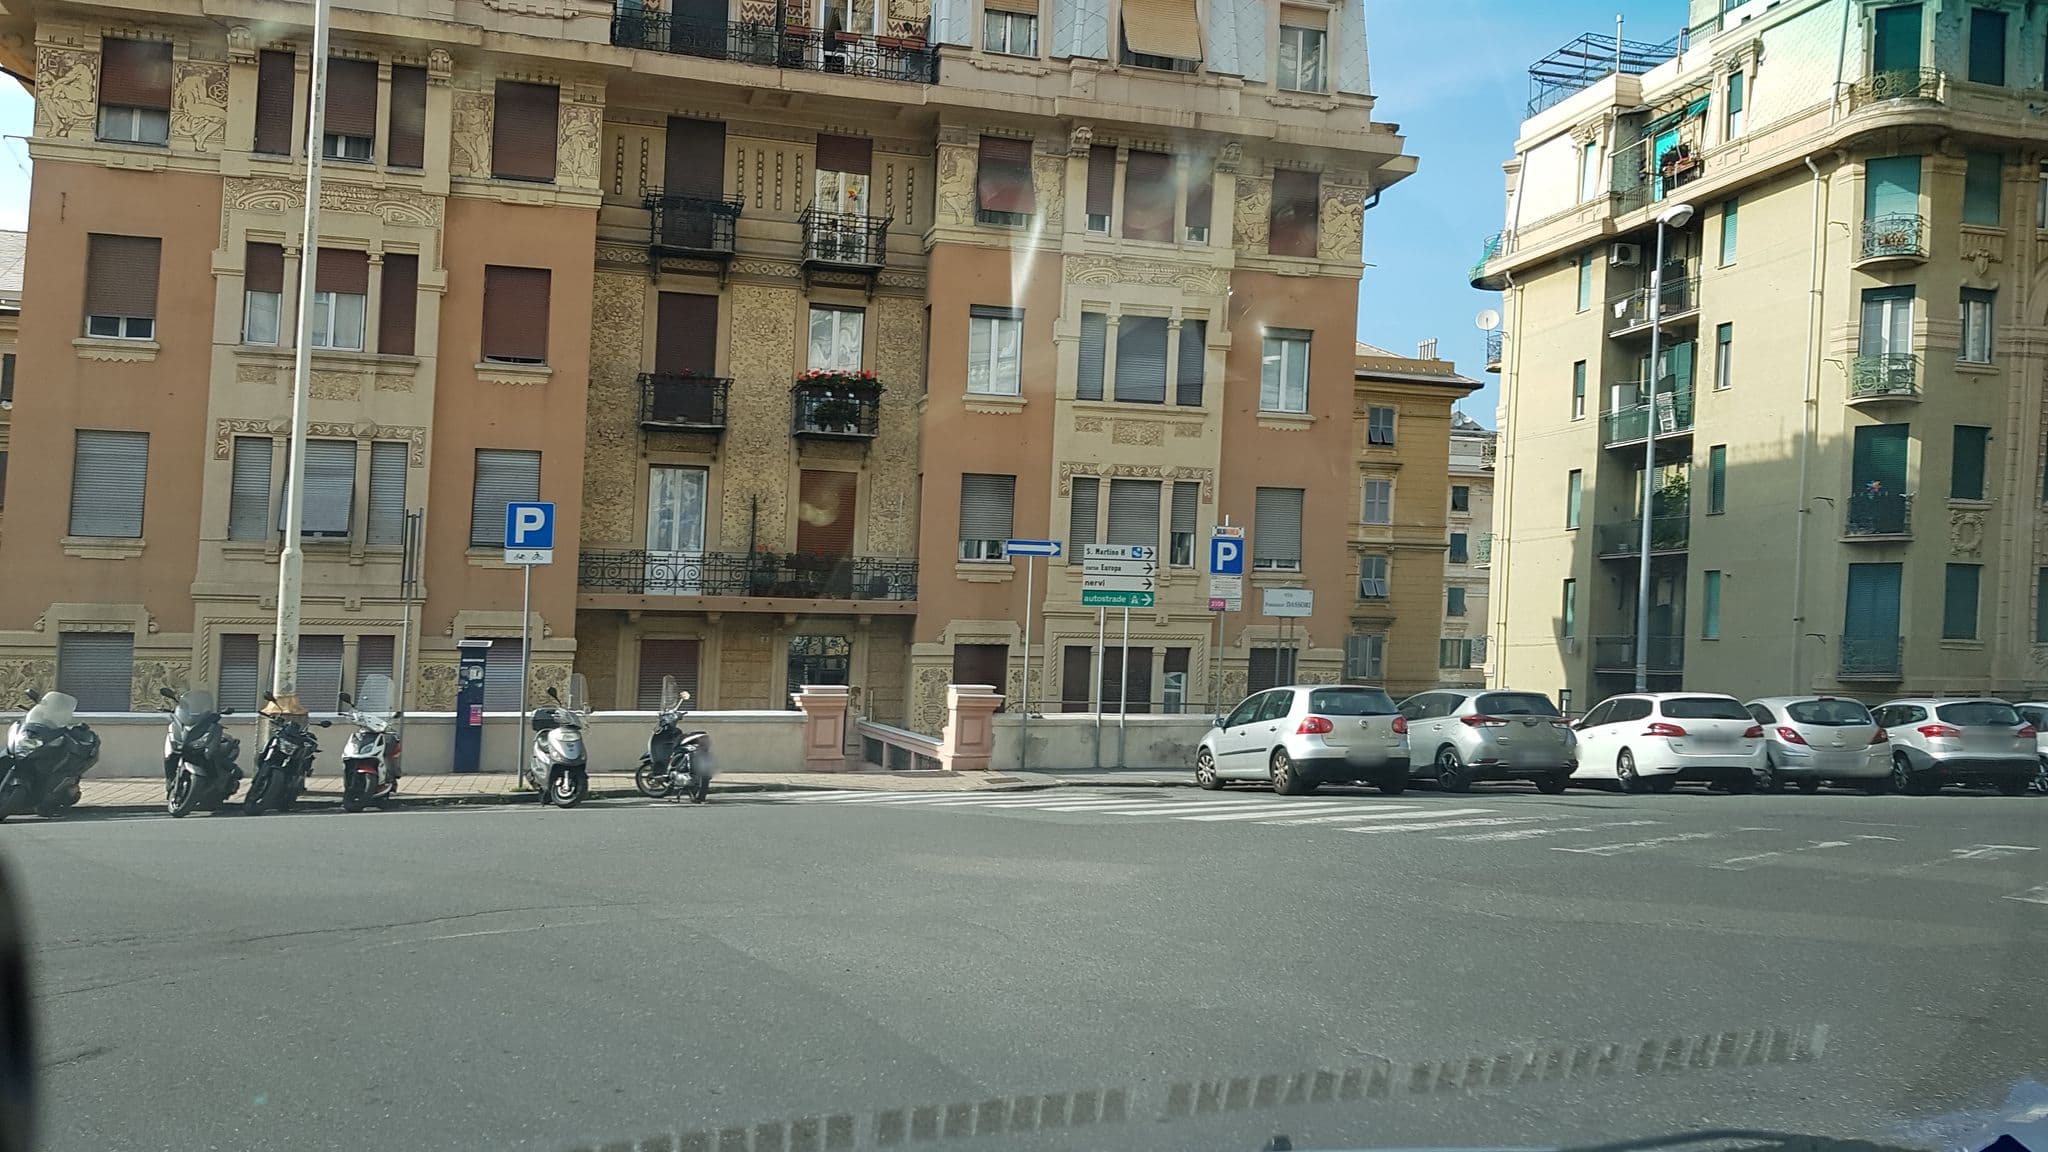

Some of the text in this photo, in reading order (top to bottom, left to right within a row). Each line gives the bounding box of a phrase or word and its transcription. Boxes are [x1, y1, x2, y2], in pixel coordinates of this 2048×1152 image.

[515, 507, 545, 543] P
[1096, 548, 1119, 556] Martino
[1217, 542, 1237, 570] P
[1101, 564, 1122, 572] Europa
[1084, 595, 1126, 603] autostrade
